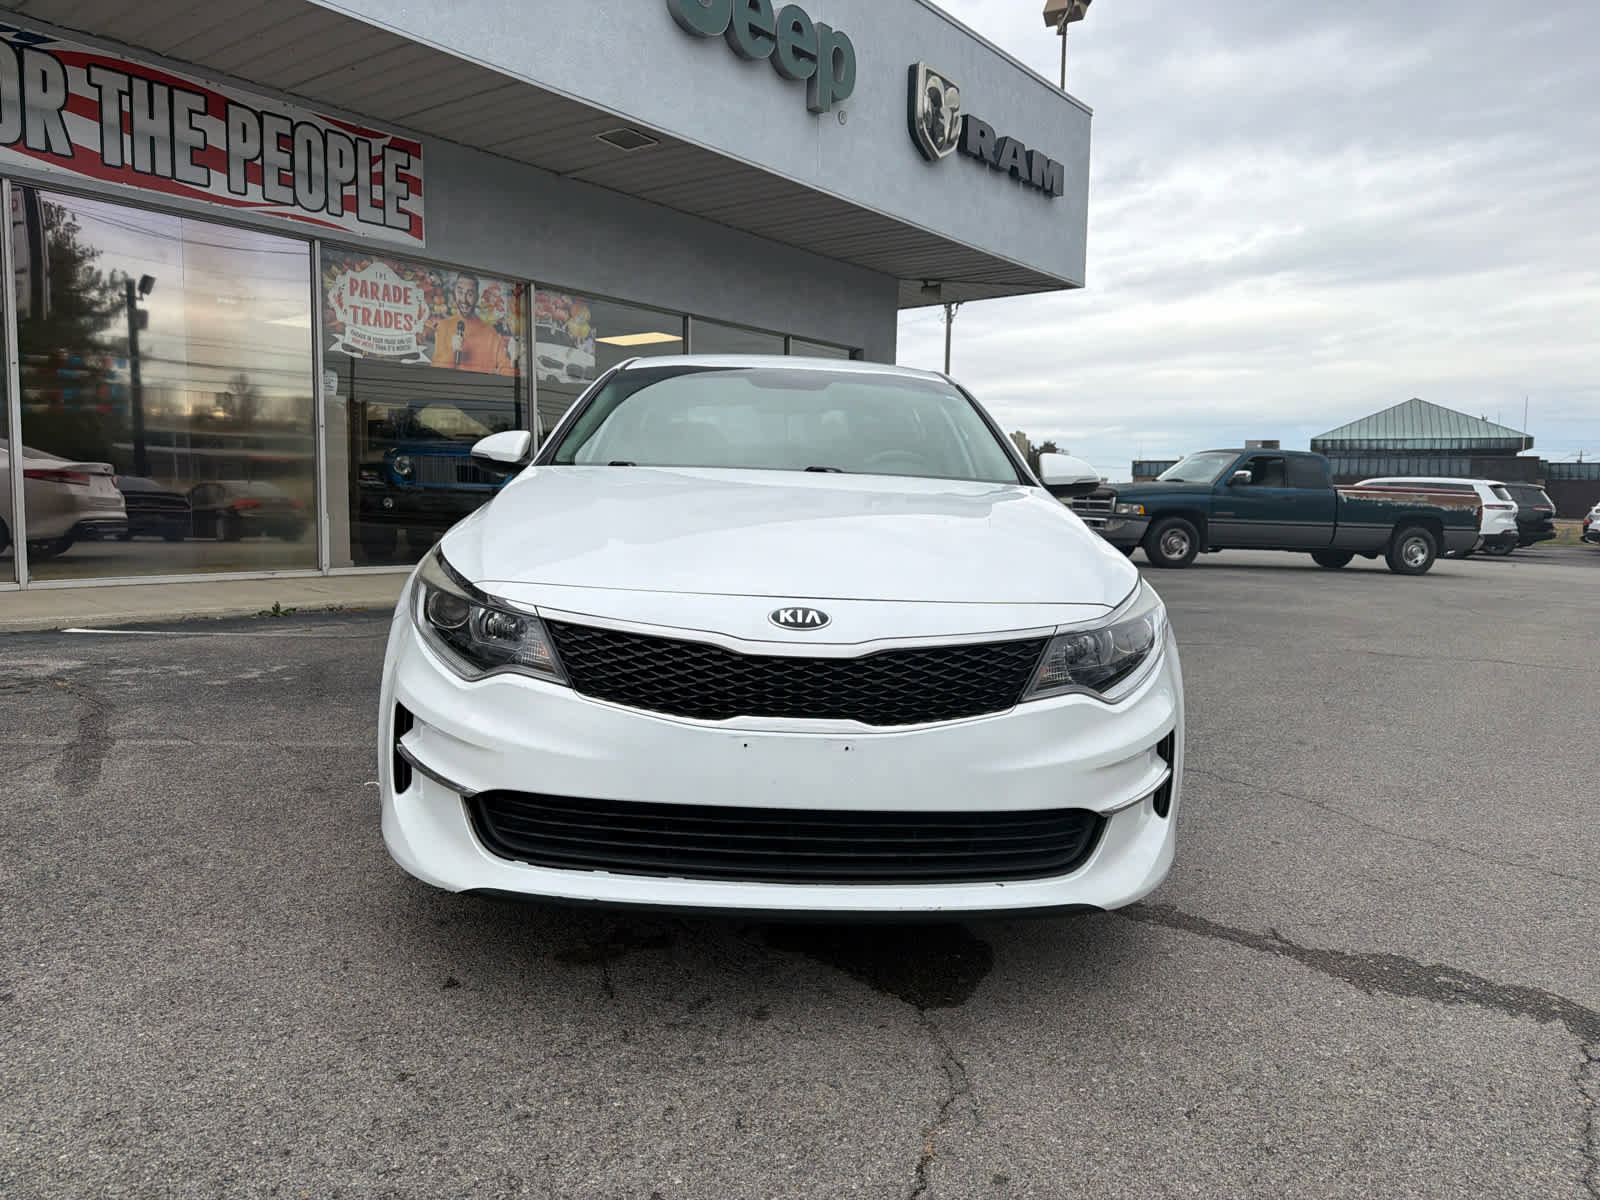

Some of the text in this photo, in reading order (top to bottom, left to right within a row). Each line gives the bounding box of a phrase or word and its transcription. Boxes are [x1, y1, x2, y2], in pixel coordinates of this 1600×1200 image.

[87, 63, 210, 188] THE
[224, 98, 412, 232] PEOPLE
[958, 113, 1065, 199] RAM
[349, 277, 413, 306] PARADE
[348, 304, 414, 332] TRADES
[779, 608, 822, 625] KIA
